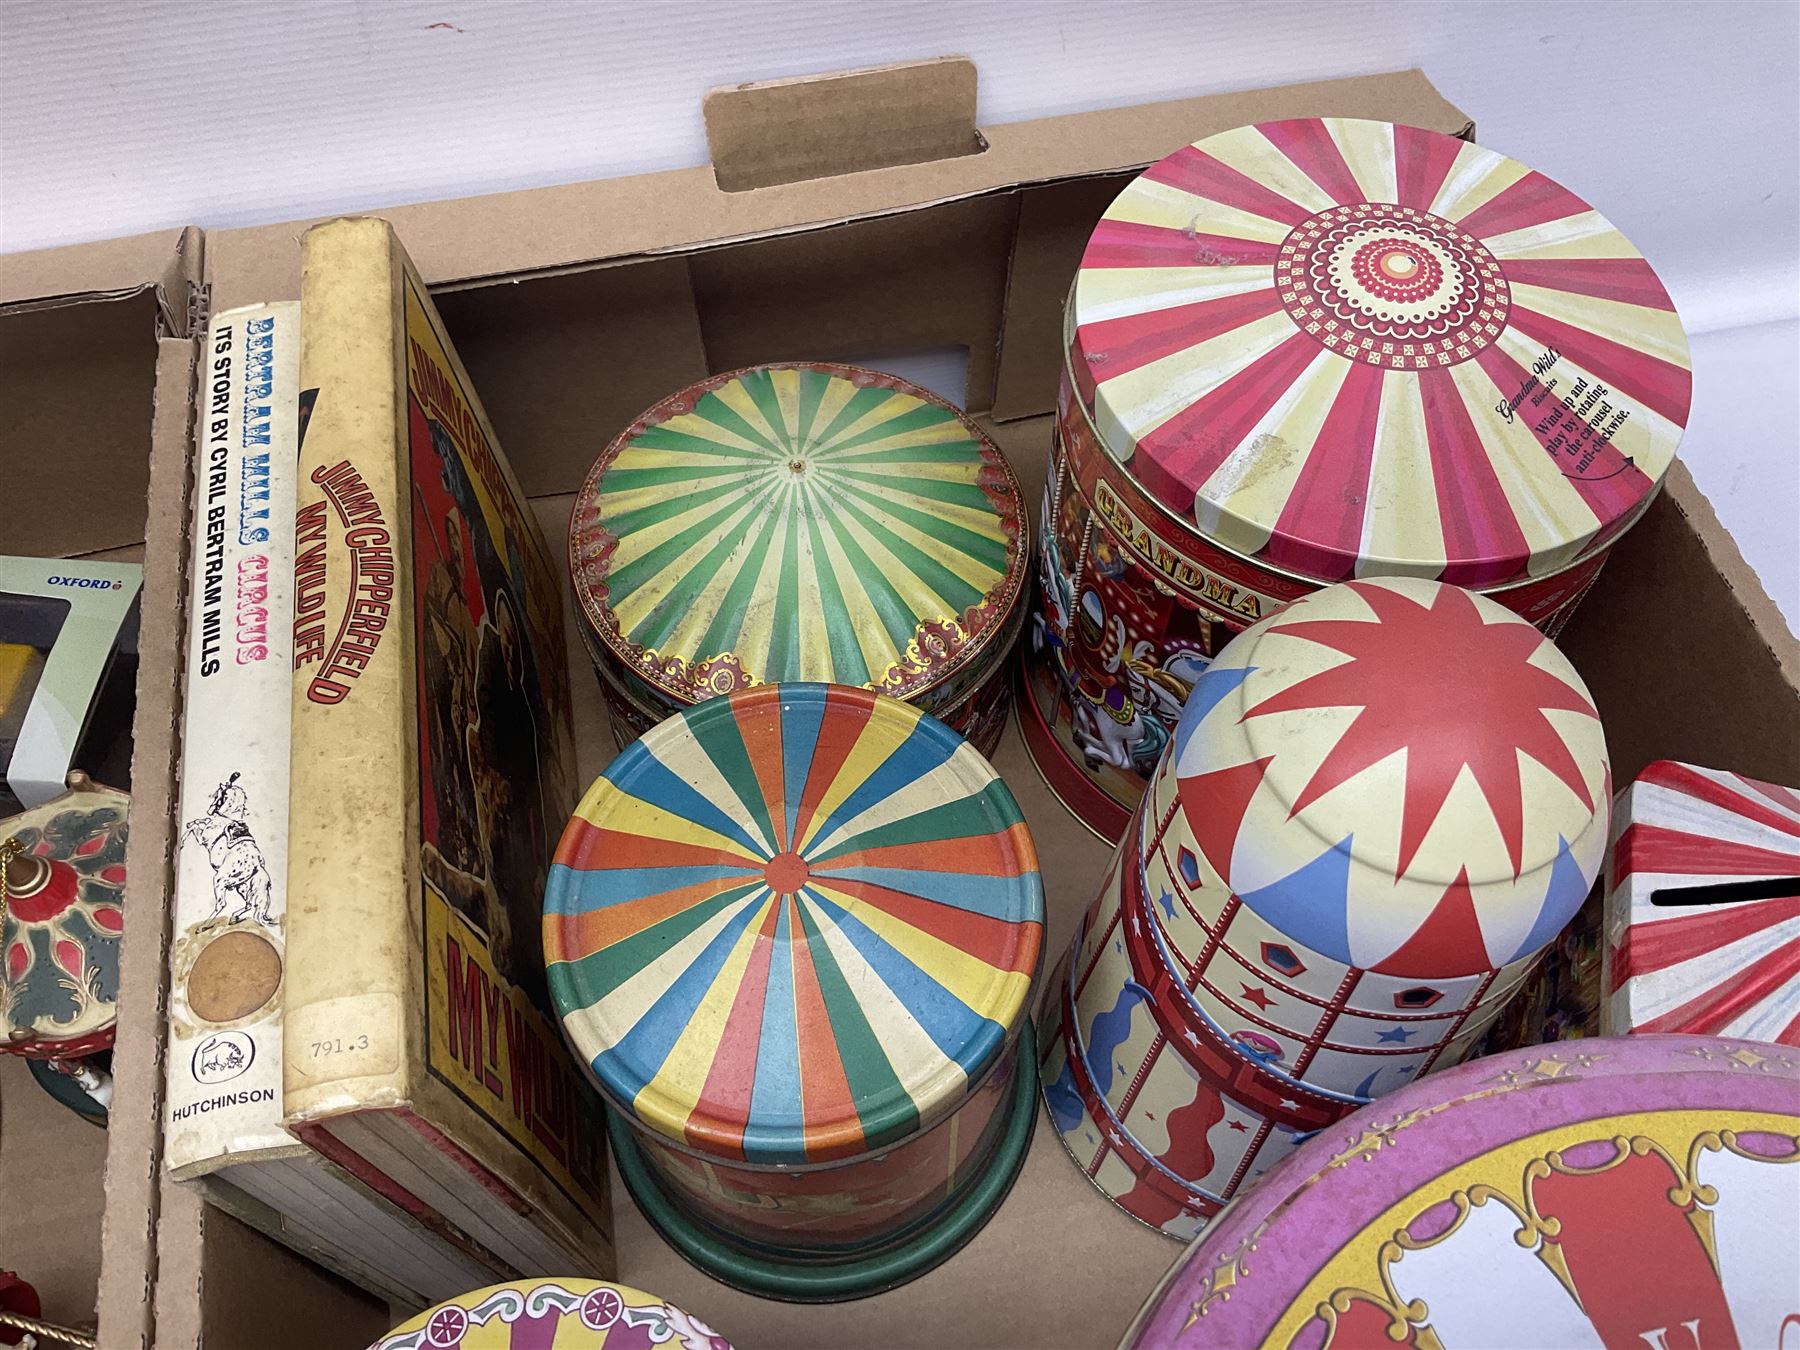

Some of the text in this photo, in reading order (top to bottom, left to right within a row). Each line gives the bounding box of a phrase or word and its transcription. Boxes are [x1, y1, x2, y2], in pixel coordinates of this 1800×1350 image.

[1495, 375, 1540, 424] Grandma
[1531, 378, 1558, 407] Biscuits
[1535, 376, 1588, 436] Wind up and
[1546, 383, 1609, 457] play by rotating
[1565, 400, 1613, 456] the carousel
[1575, 410, 1631, 474] anti-clockwise.
[200, 325, 233, 678] ITS STORY BY CYRIL BERTRAM MILLS
[235, 317, 275, 665] BERTRAM MILLS CIRCUS
[295, 500, 327, 545] MY
[47, 575, 112, 590] OXFORD
[306, 459, 395, 705] JIMMY CHIPPERFIELD
[1097, 487, 1262, 619] GRANDMA
[446, 931, 503, 1101] MY
[311, 1035, 369, 1058] 791.3
[172, 1088, 274, 1122] HUTCHINSON
